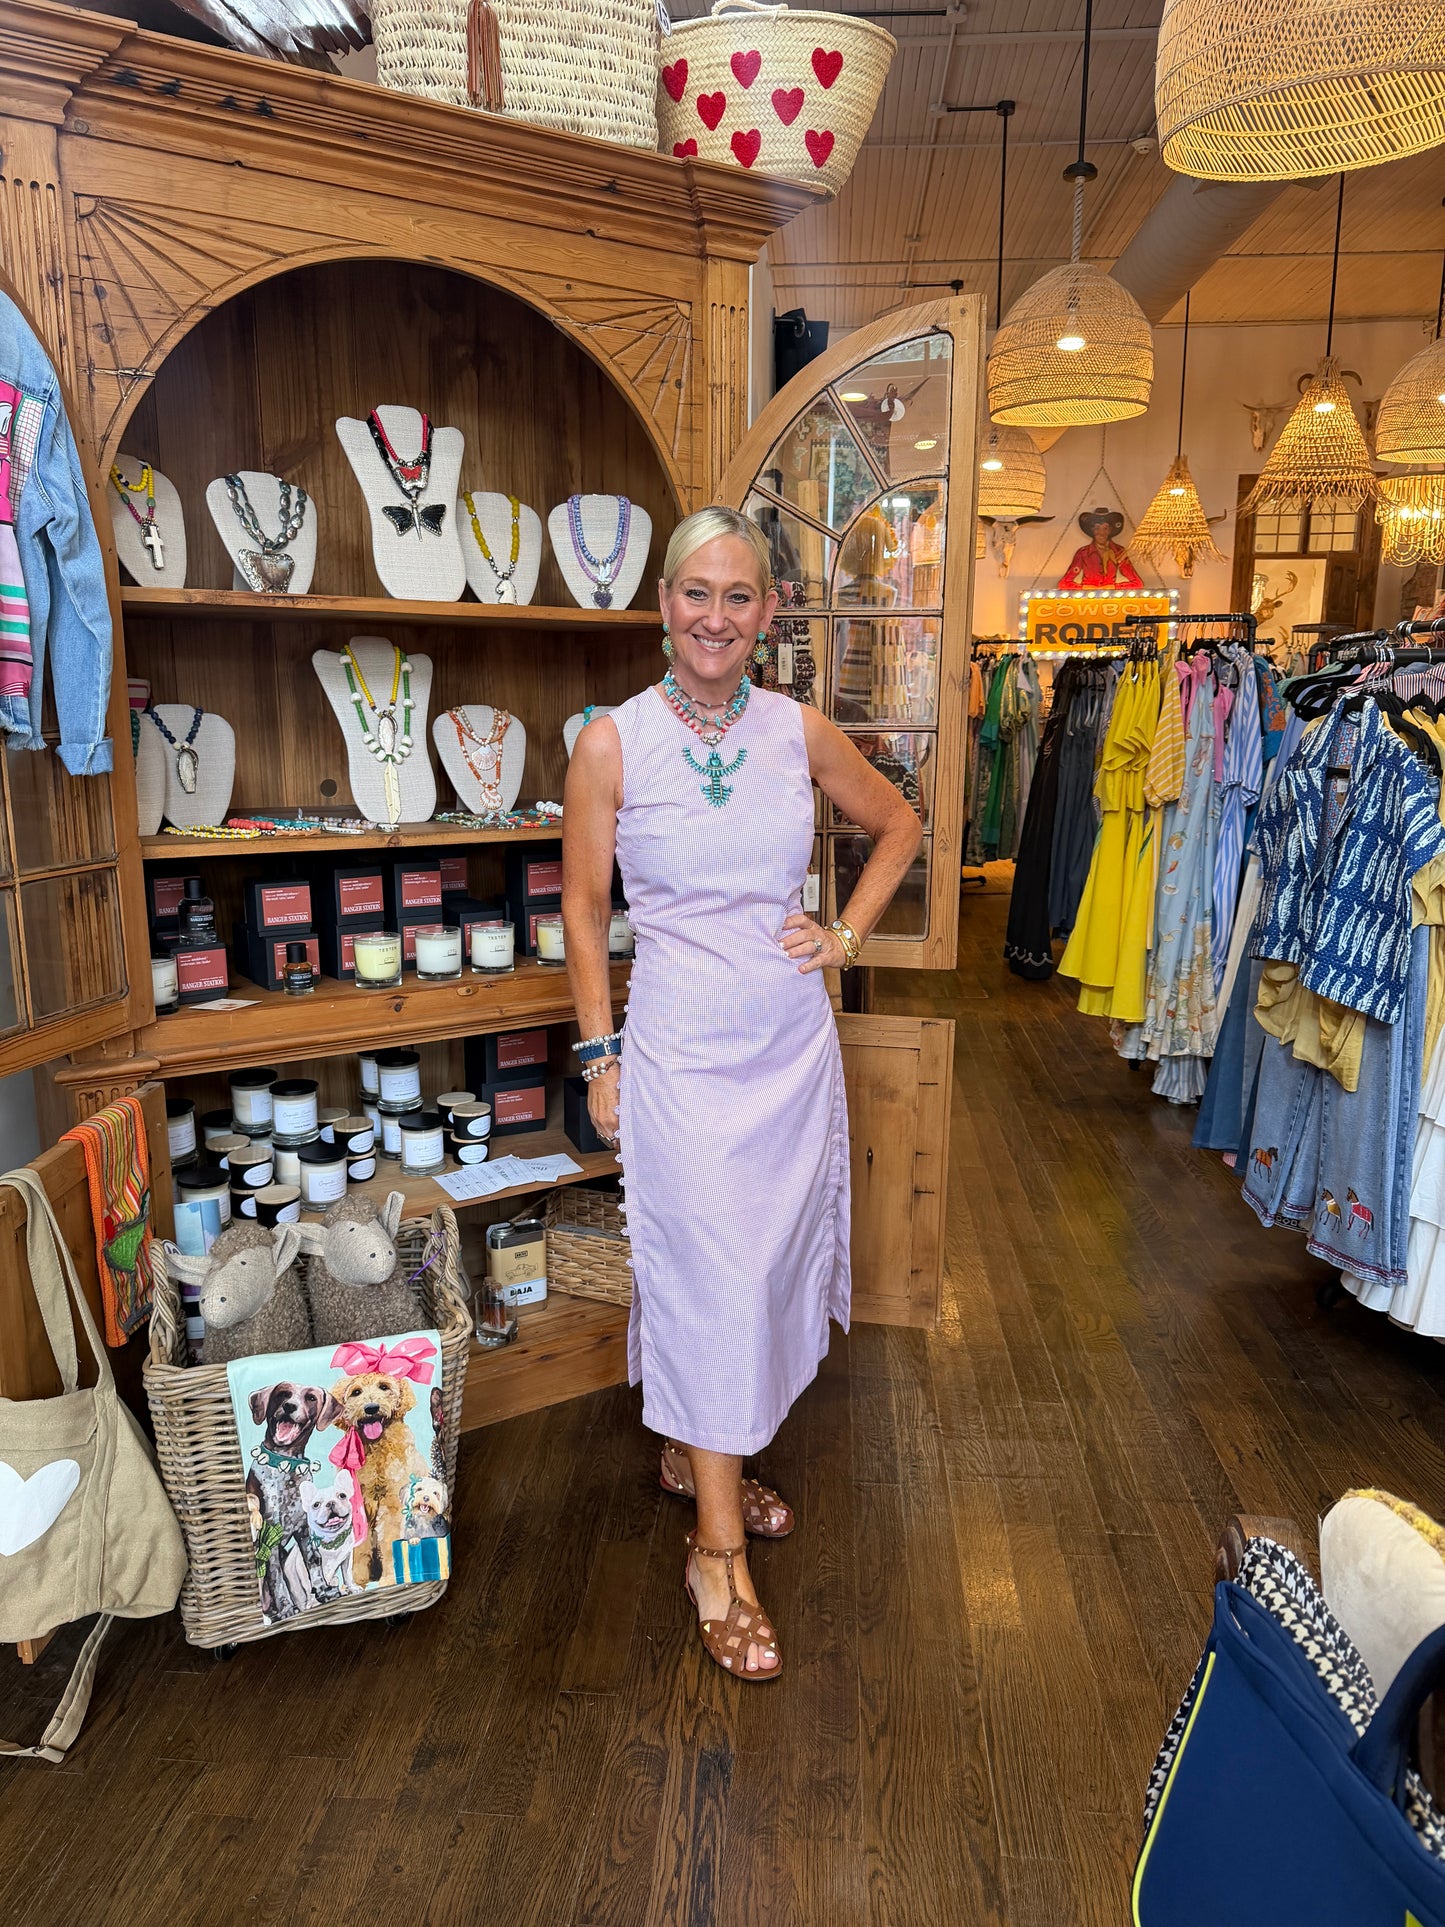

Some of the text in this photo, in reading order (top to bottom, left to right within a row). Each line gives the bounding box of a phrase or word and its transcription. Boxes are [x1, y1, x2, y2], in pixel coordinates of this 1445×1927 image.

[1035, 603, 1163, 617] COWBOY
[405, 897, 424, 905] RANGER
[344, 903, 381, 913] RANGER STATION
[267, 913, 309, 924] RANGER STATION
[182, 978, 224, 990] RANGER STATION
[500, 1058, 517, 1067] RANGER
[497, 1112, 533, 1123] RANGER STATION
[510, 1286, 533, 1297] BAJA
